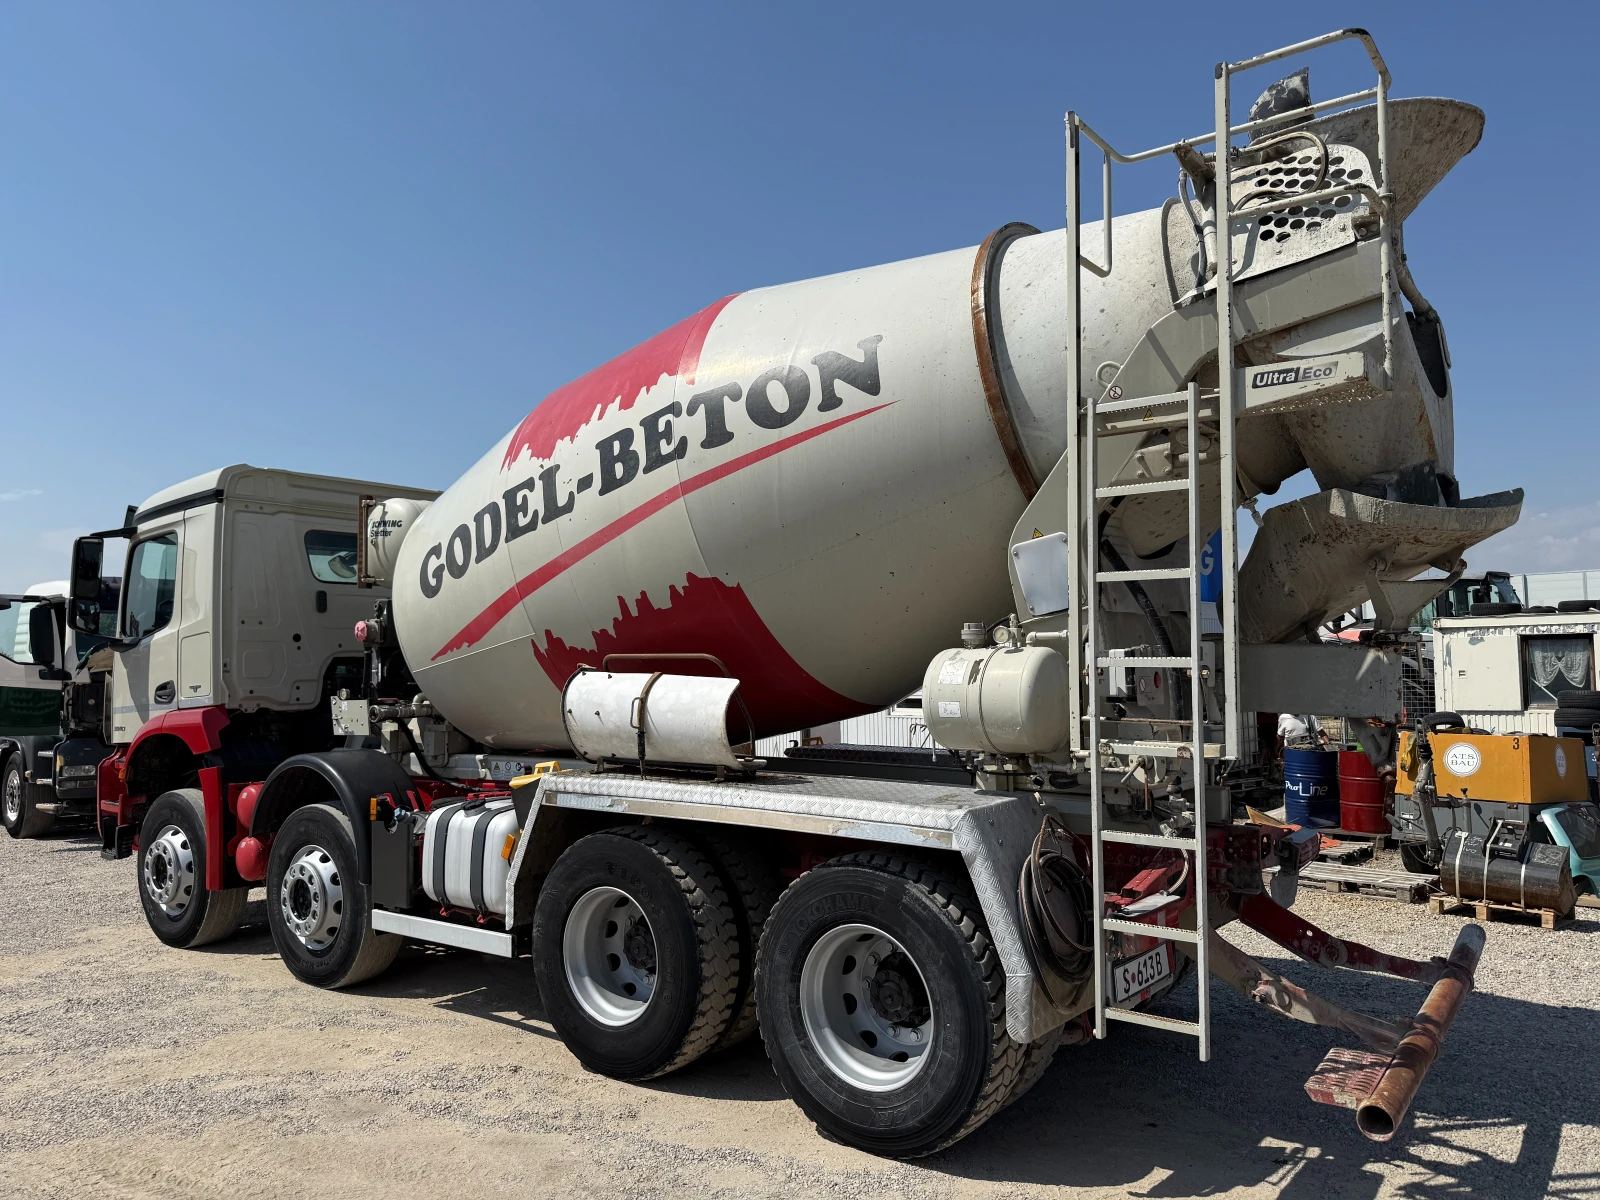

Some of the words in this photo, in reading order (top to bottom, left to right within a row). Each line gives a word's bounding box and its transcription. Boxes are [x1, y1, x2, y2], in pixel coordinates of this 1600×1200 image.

[1256, 371, 1296, 386] Ultra
[1302, 367, 1333, 380] Eco
[419, 334, 883, 599] GODEL-BETON
[371, 519, 403, 529] SCHWING
[1512, 737, 1520, 750] 3
[1137, 951, 1163, 987] 613B
